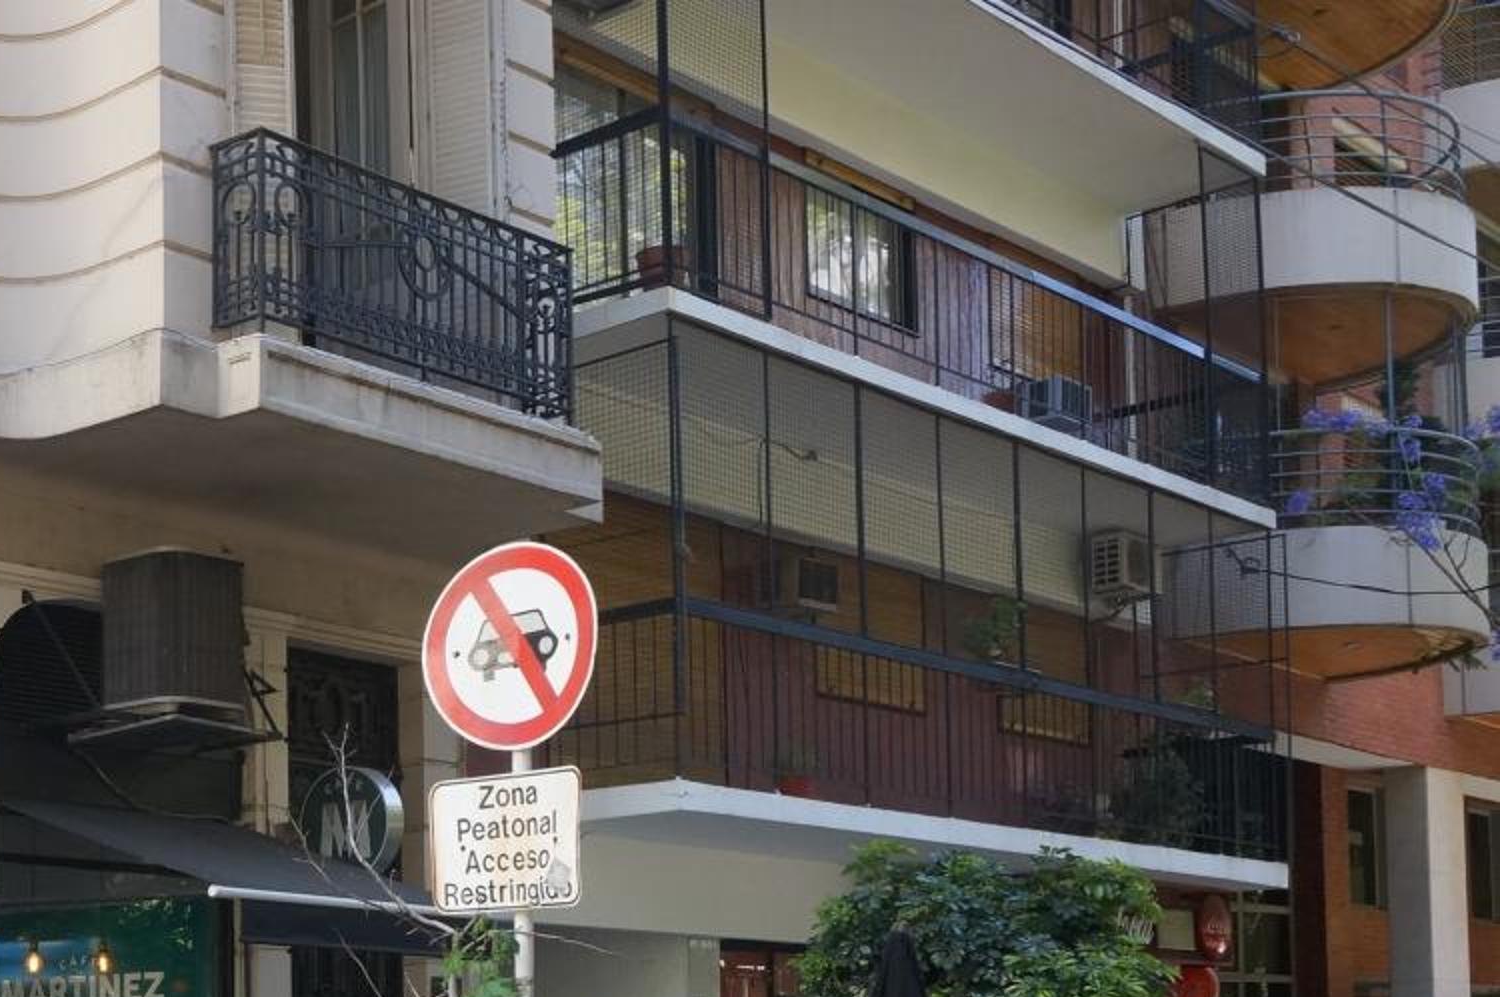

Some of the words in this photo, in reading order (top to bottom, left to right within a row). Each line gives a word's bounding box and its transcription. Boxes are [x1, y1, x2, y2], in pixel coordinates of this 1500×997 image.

[479, 785, 538, 810] Zona
[320, 799, 371, 859] M
[457, 810, 558, 842] Peatonal
[465, 848, 550, 875] Acceso
